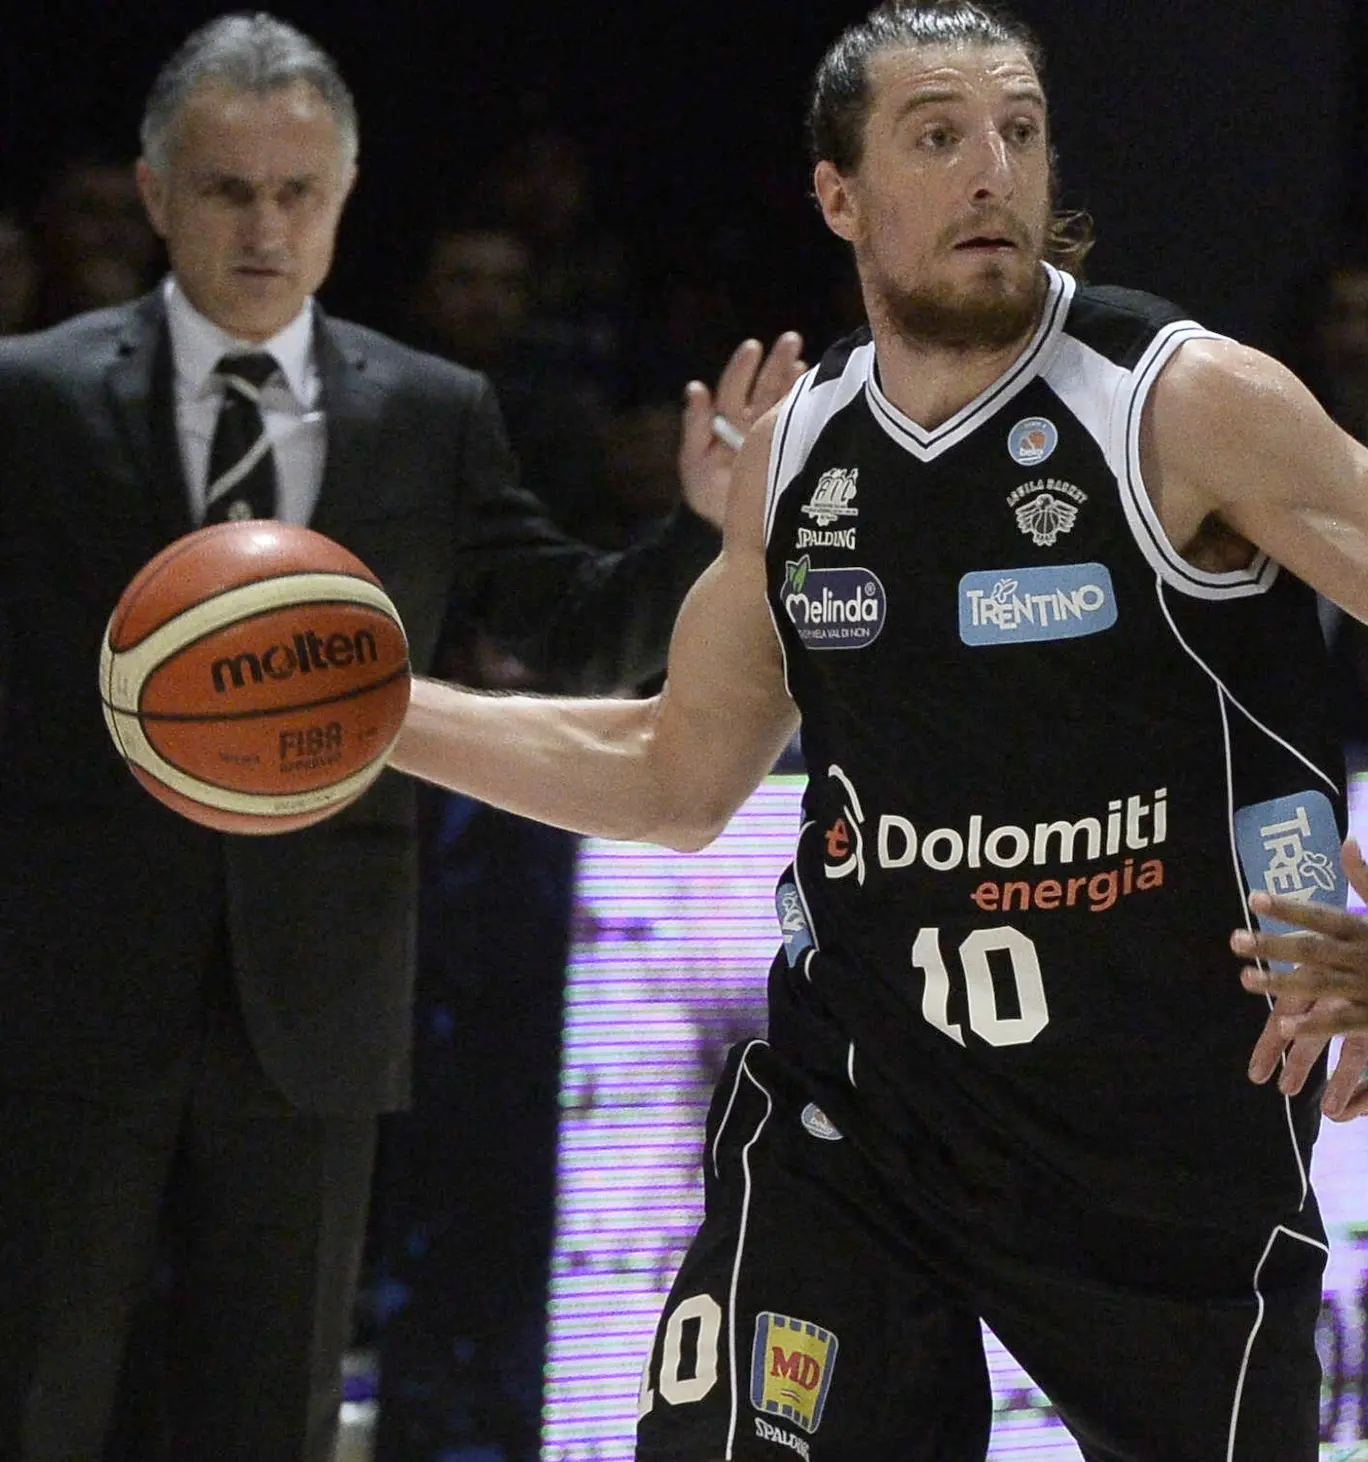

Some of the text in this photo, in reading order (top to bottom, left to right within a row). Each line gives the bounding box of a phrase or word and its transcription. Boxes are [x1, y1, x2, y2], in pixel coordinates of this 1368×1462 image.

[796, 527, 856, 550] SPALDING
[785, 585, 878, 624] Melinda
[966, 584, 1105, 629] TRENTINO
[211, 628, 378, 693] molten
[877, 787, 1168, 871] Dolomiti
[970, 857, 1165, 912] energia
[910, 925, 1050, 1047] 10
[770, 1345, 821, 1393] MD
